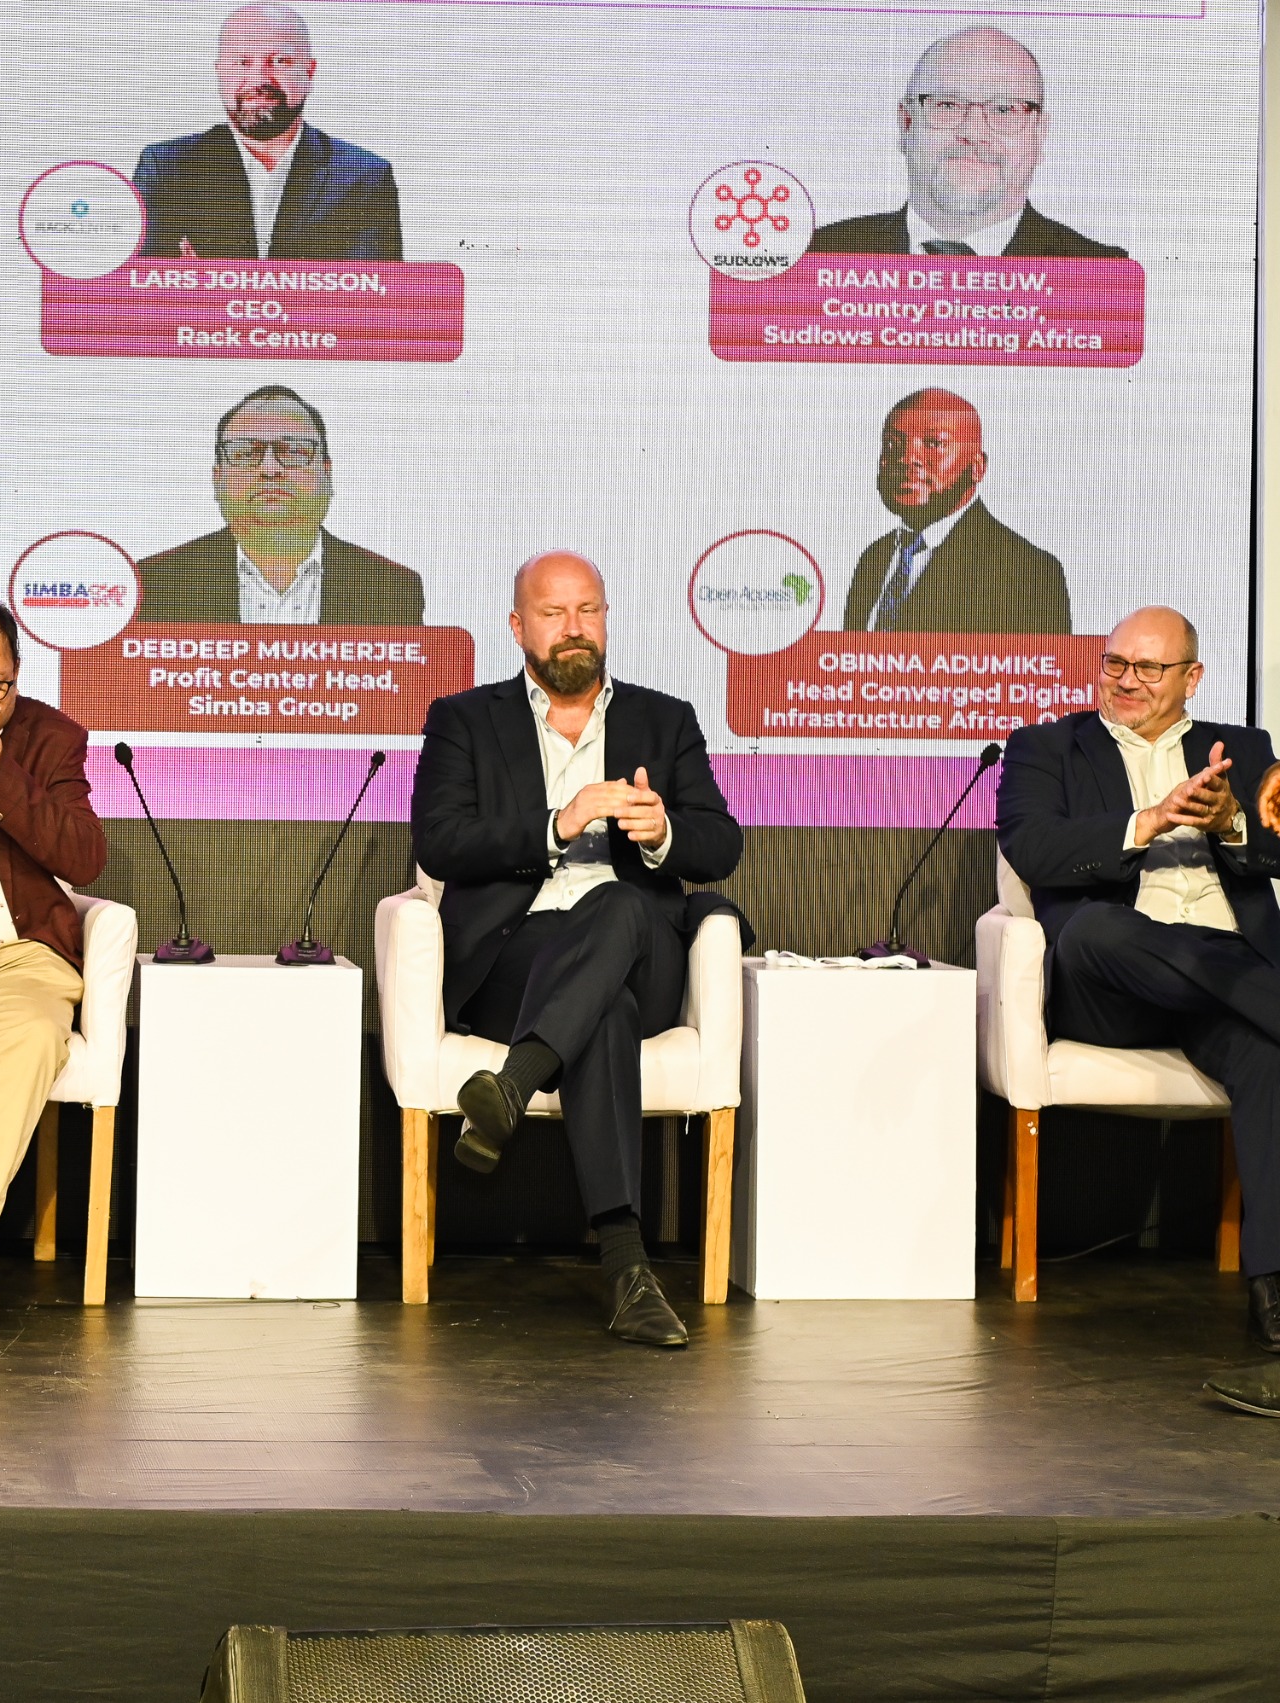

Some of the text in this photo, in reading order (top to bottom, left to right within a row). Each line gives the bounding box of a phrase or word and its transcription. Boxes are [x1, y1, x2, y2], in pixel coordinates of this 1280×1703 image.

[130, 269, 387, 295] LARS JOHANISSON,
[817, 269, 1053, 295] RIAAN DE LEEUW,
[226, 300, 289, 322] CEO,
[822, 299, 1046, 323] Country Director,
[177, 327, 337, 349] Rack Centre
[764, 326, 1102, 352] Sudlows Consulting Africa
[123, 638, 427, 665] DEBDEEP MUKHERJEE,
[819, 652, 1062, 678] OBINNA ADUMIKE,
[150, 667, 399, 693] Profit Center Head,
[787, 680, 1093, 709] Head Converged Digital
[188, 697, 359, 721] Simba Group
[764, 707, 941, 728] Infrastructure
[949, 709, 1028, 730] Africa
